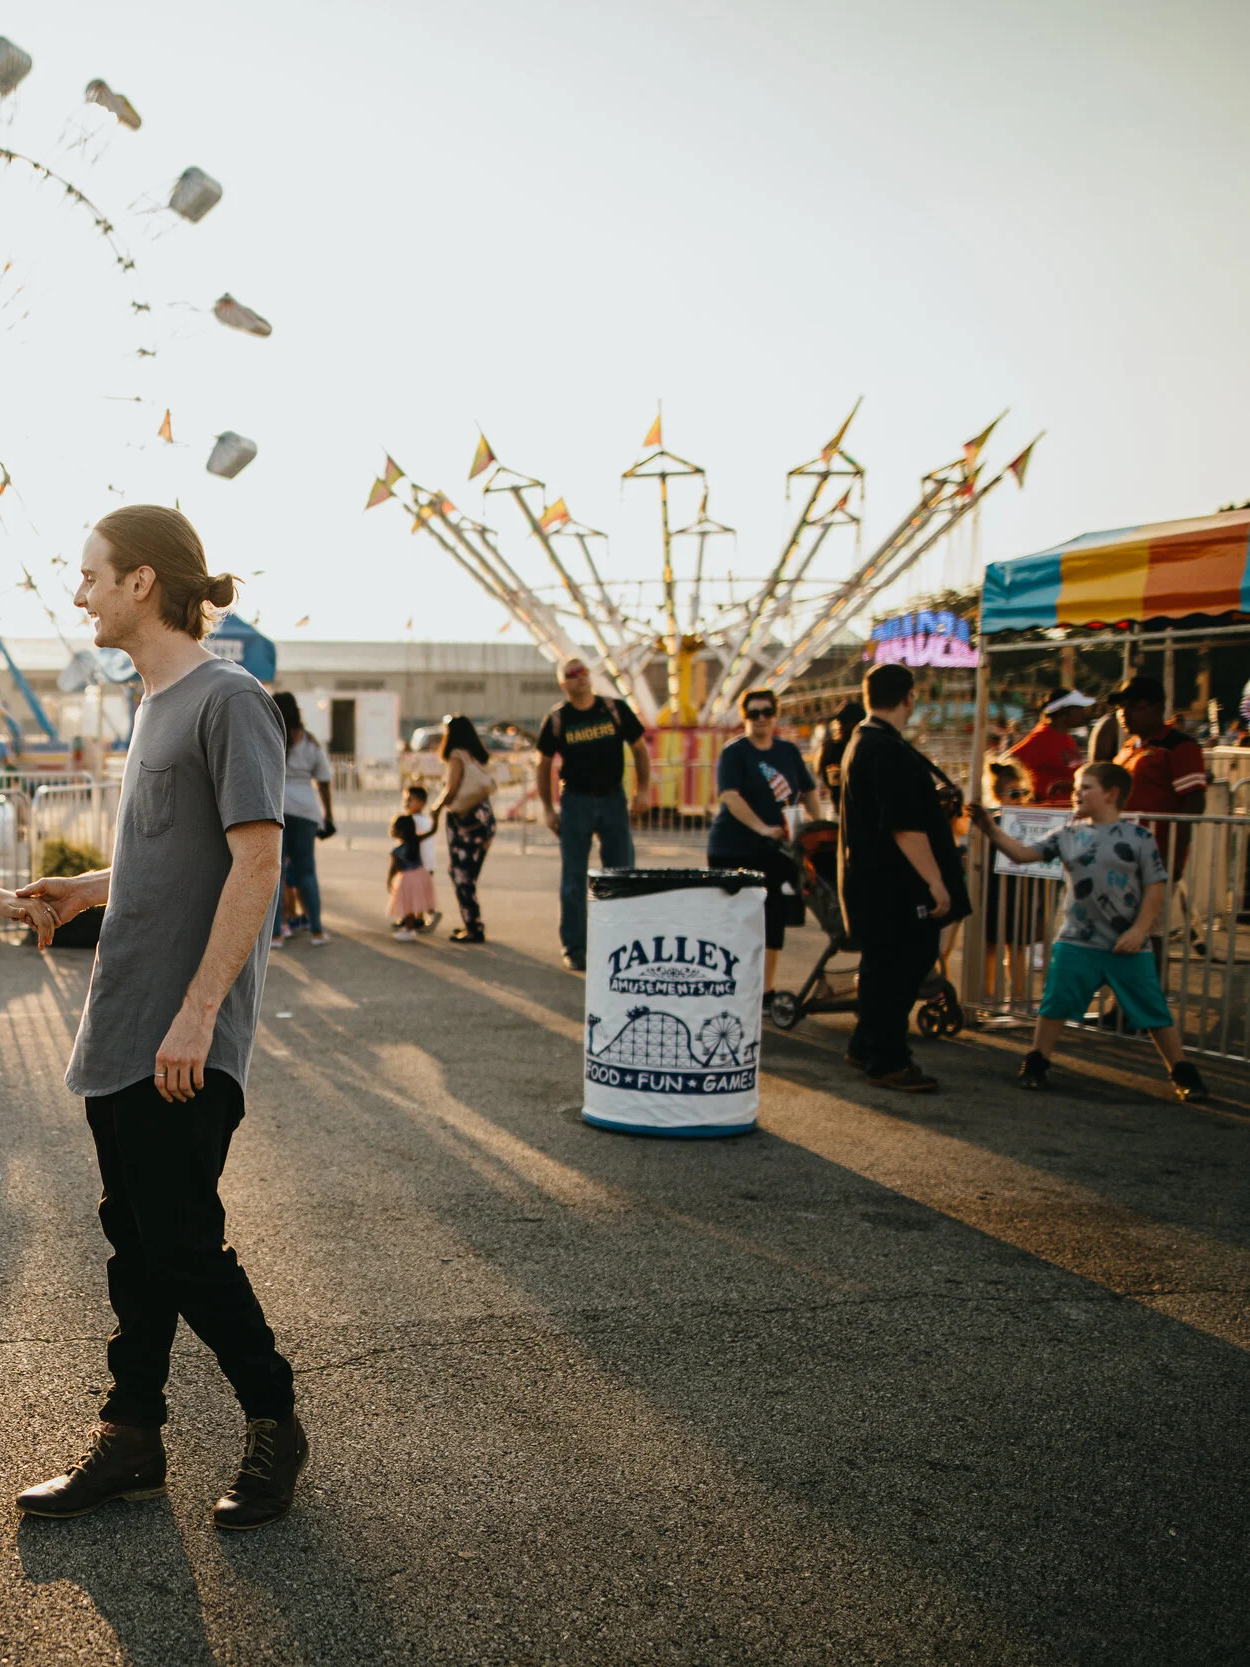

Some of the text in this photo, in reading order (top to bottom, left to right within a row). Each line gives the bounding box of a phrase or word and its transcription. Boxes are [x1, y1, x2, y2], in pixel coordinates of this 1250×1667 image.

[565, 722, 616, 745] RAIDERS
[608, 936, 740, 980] TALLEY
[637, 1073, 683, 1092] FUN
[703, 1071, 754, 1092] GAMES
